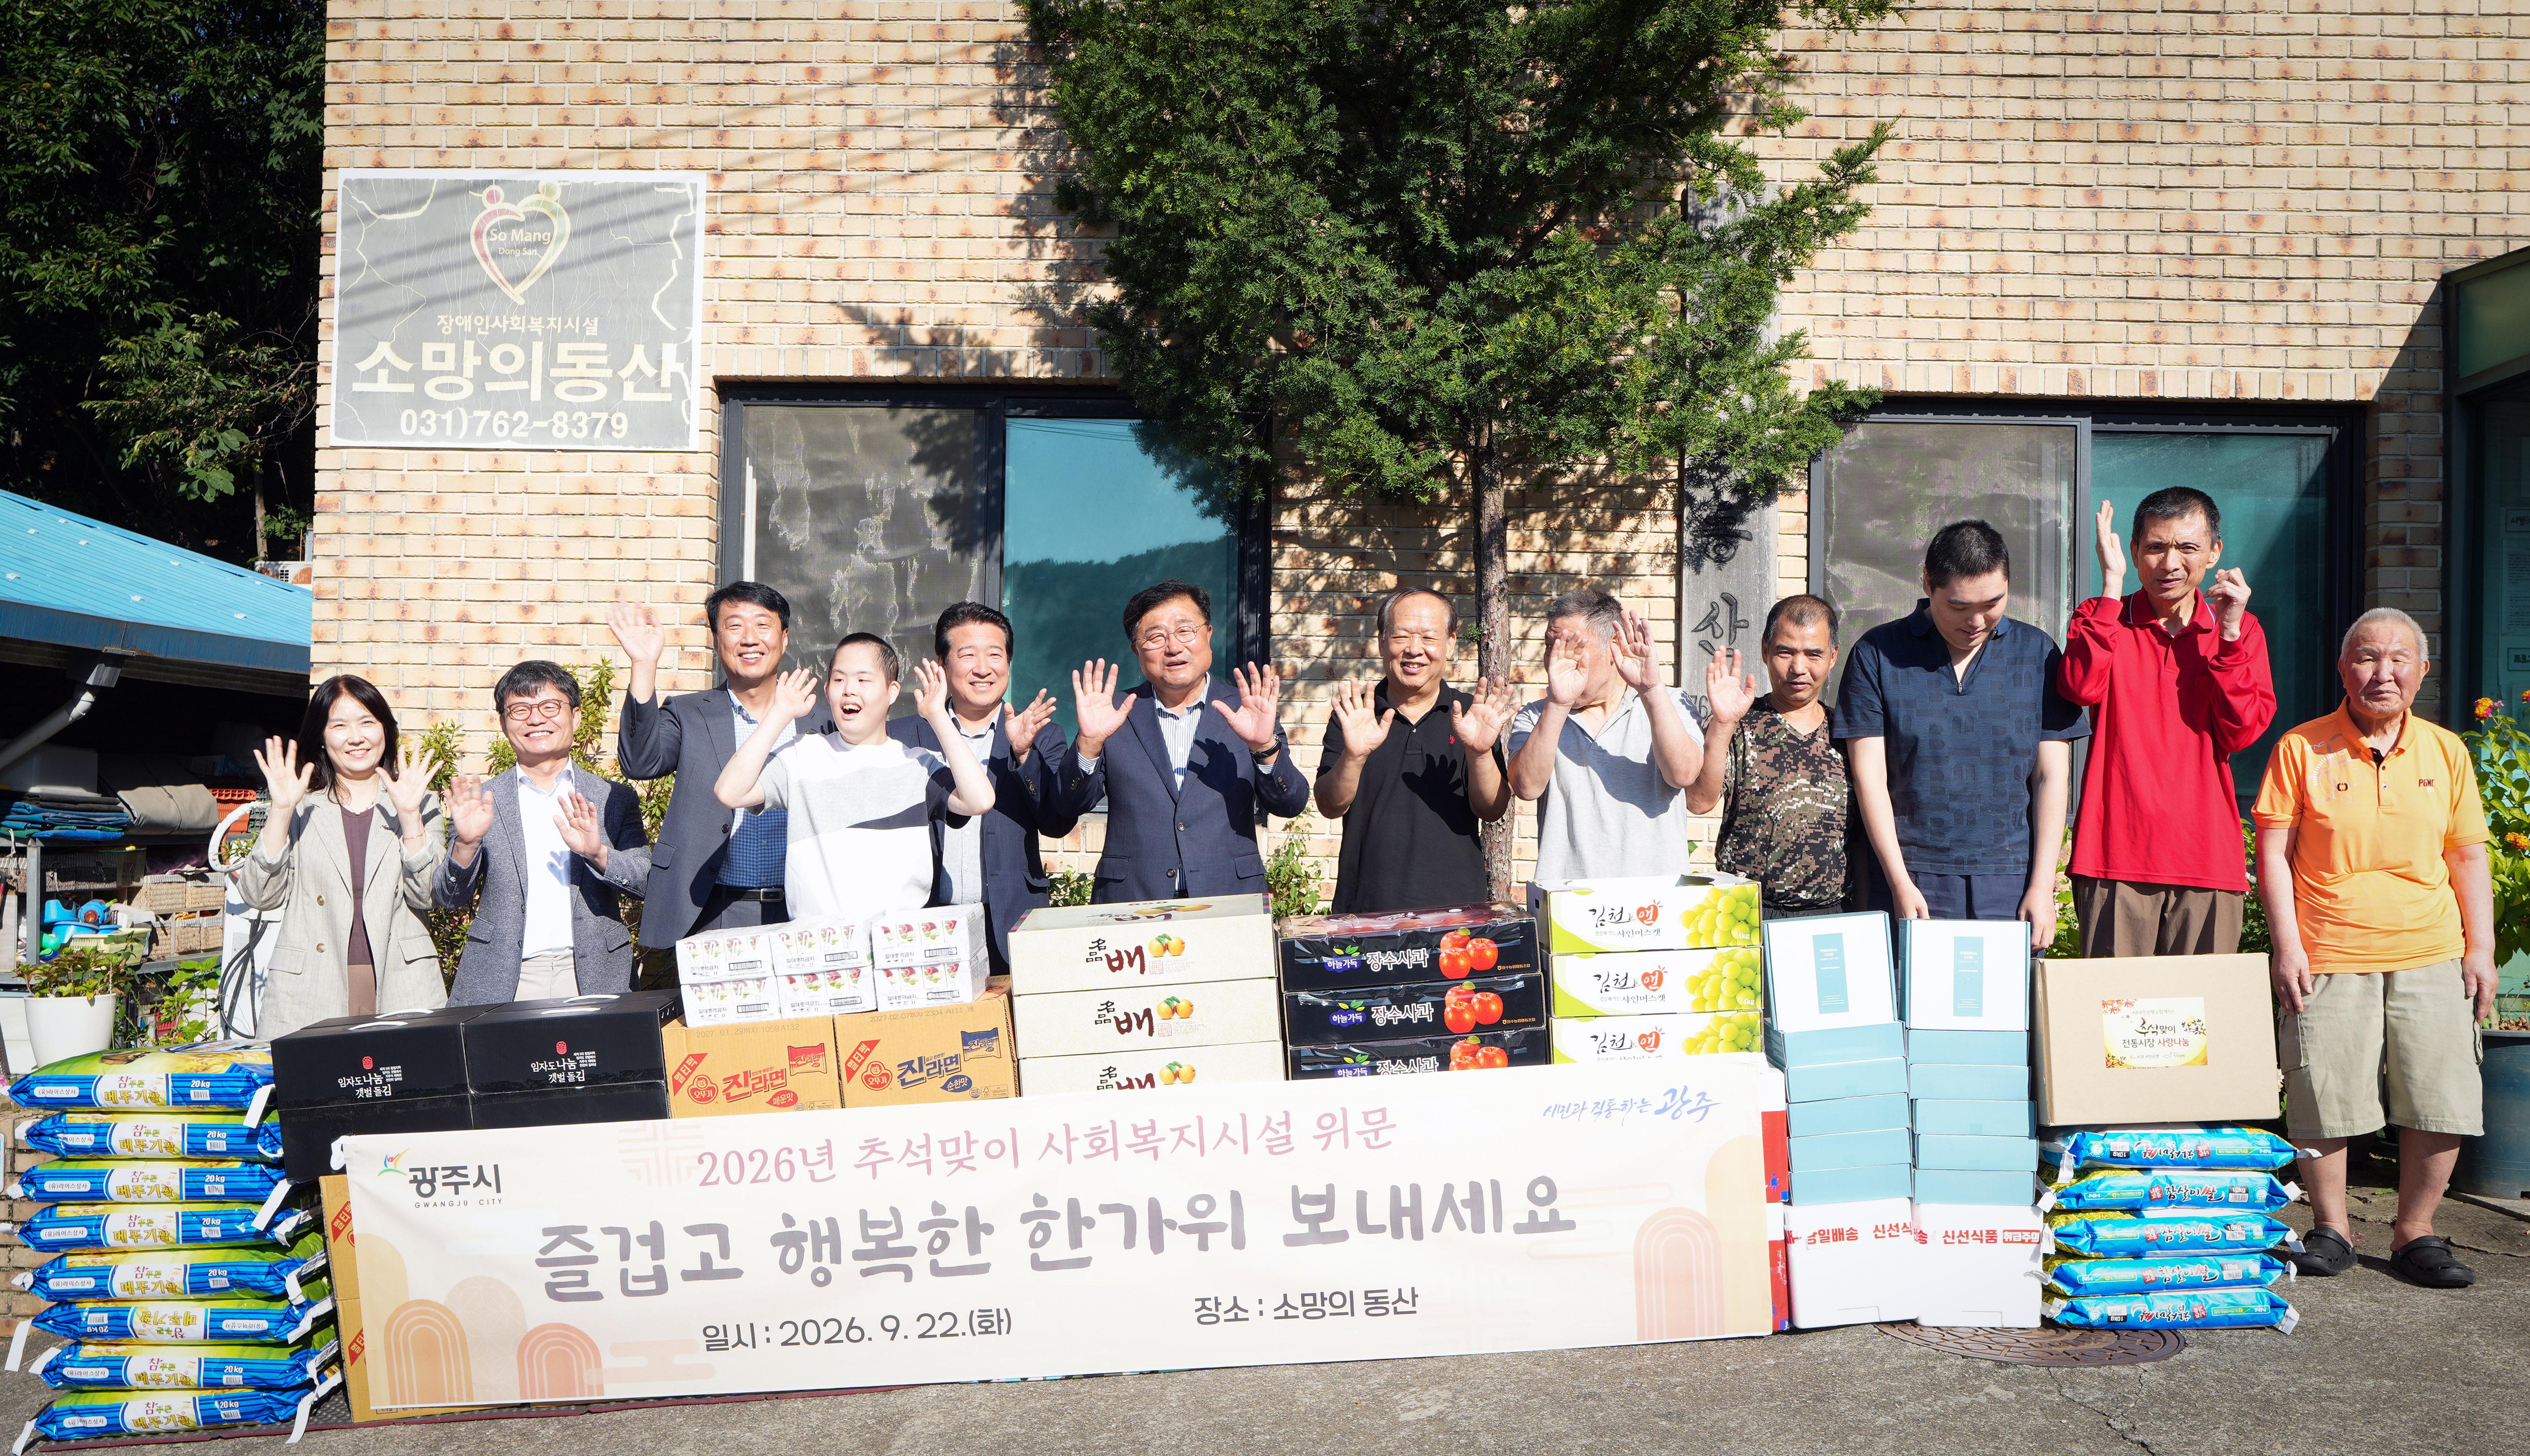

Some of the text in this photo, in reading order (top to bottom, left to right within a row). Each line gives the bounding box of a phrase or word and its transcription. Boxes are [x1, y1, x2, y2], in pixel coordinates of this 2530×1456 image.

[489, 228, 551, 245] So Mang
[498, 247, 537, 256] Dong San
[437, 315, 599, 335] 장애인사회복지시설
[352, 340, 681, 402] 소망의동산
[400, 408, 628, 439] 031)762-8379
[1589, 905, 1623, 927] 김천
[1617, 928, 1660, 938] 샤인머스켓
[1105, 945, 1146, 975] 배
[1327, 948, 1429, 972] 하늘가득 장수사과
[1593, 971, 1628, 993] 김천
[1622, 994, 1665, 1003] 샤인머스켓
[1332, 1002, 1434, 1026] 하늘가득 장수사과
[1114, 1008, 1154, 1037] 배
[2134, 1017, 2176, 1037] 추석맞이
[1590, 1032, 1625, 1054] 김천
[2122, 1038, 2189, 1048] 전통시장 사랑나눔
[847, 1043, 871, 1070] 멀티팩
[531, 1058, 577, 1072] 임자도나눔
[674, 1056, 698, 1083] 멀티팩
[897, 1053, 961, 1089] 진라면
[1337, 1056, 1439, 1078] 하늘가득 장수사과
[338, 1073, 383, 1088] 임자도나눔
[549, 1069, 585, 1084] 갯벌 돌김
[868, 1078, 887, 1086] 오뚜기
[38, 1088, 76, 1097] (유)라이스상사
[356, 1084, 392, 1098] 갯벌 돌김
[723, 1068, 787, 1102] 진라면
[947, 1079, 967, 1091] 순한맛
[104, 1090, 160, 1105] 메뚜기쌀
[773, 1093, 793, 1105] 매운맛
[1543, 1101, 1588, 1122] 시민과
[1654, 1085, 1720, 1123] 광주
[120, 1139, 175, 1154] 메뚜기쌀
[697, 1107, 1398, 1188] 2026년 추석맞이 사회복지시설 위문
[48, 1182, 87, 1190] (유)라이스상사
[409, 1164, 502, 1199] 광주시
[116, 1185, 173, 1199] 메뚜기쌀
[414, 1200, 469, 1209] GWANGJU
[45, 1229, 84, 1238] (유)라이스상사
[114, 1229, 170, 1244] 메뚜기쌀
[535, 1175, 1576, 1303] 즐겁고 행복한 한가위 보내세요
[1942, 1229, 2040, 1245] 신선식품 취급주의
[52, 1278, 92, 1288] (유)라이스상사
[120, 1282, 177, 1296] 메뚜기쌀
[1274, 1290, 1355, 1320] 소망의
[1364, 1287, 1418, 1317] 동산
[66, 1368, 106, 1378] (유)라이스상사
[135, 1372, 191, 1387] 메뚜기쌀
[132, 1414, 190, 1429] 메뚜기쌀
